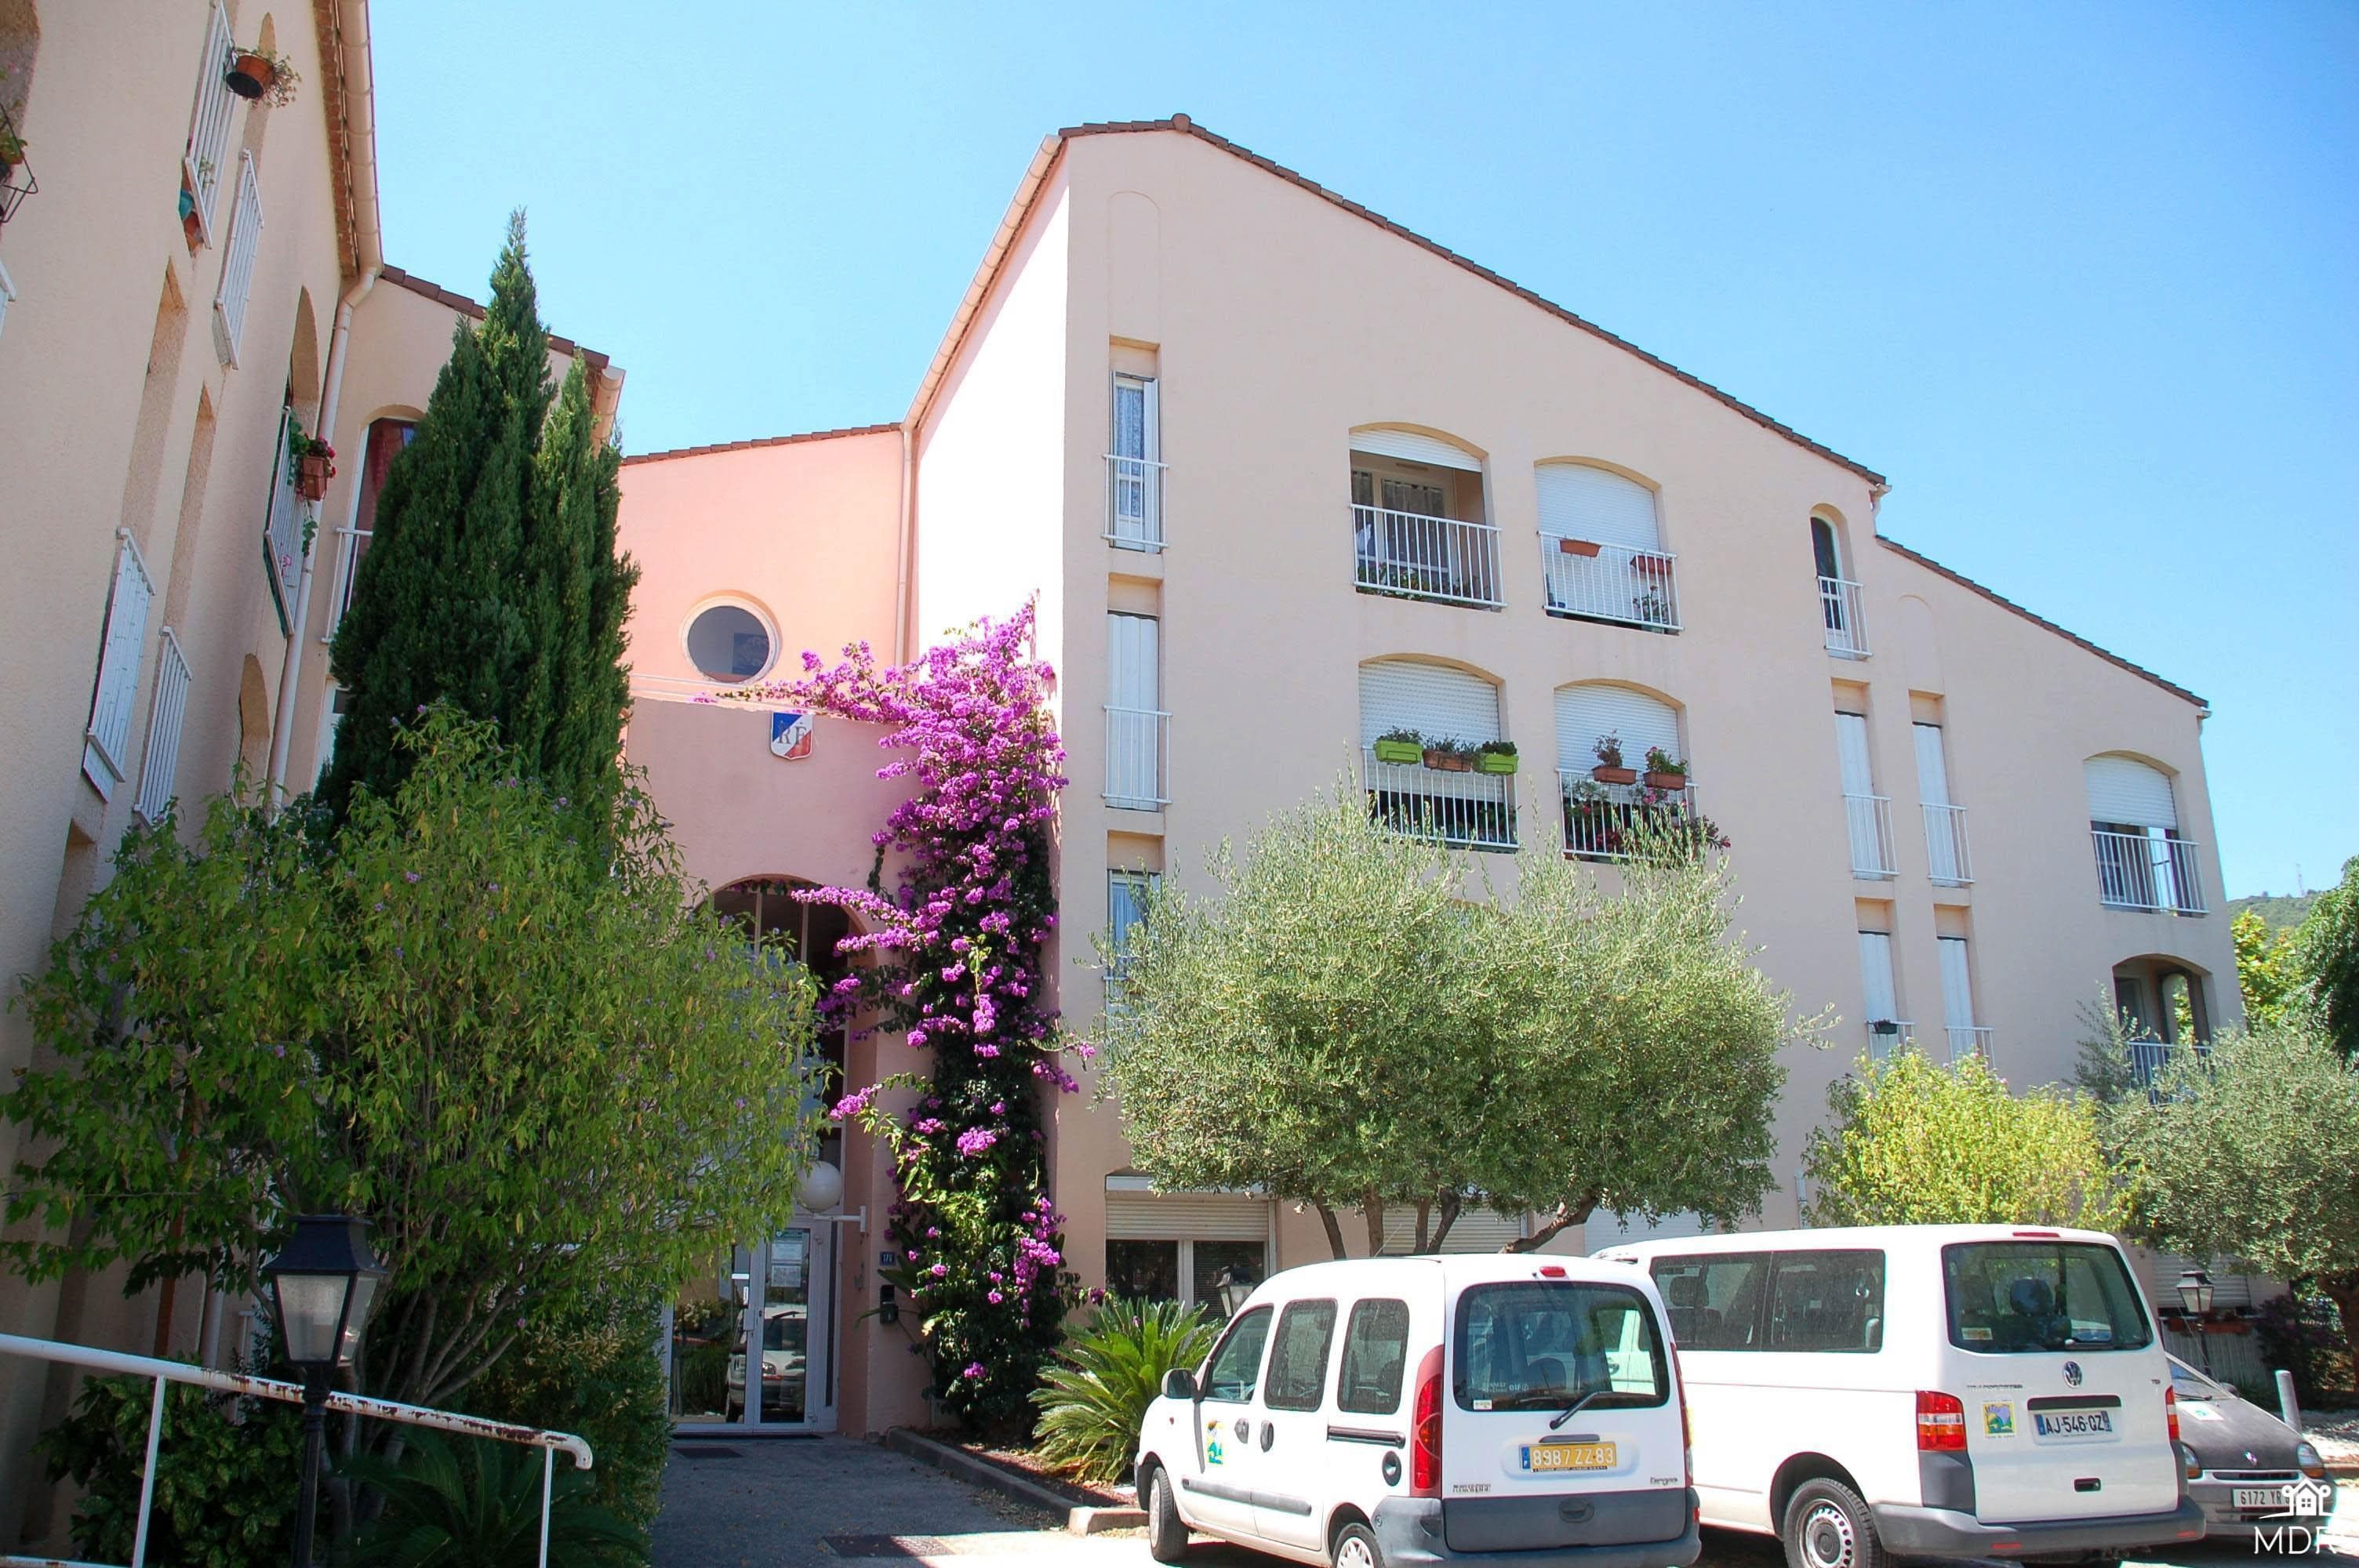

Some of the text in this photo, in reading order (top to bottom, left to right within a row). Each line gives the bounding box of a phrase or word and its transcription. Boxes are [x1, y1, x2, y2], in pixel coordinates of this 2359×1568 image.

[1574, 1448, 1593, 1465] ZZ
[1595, 1447, 1613, 1464] 83
[2240, 1491, 2266, 1505] 6172
[2270, 1490, 2281, 1504] YR
